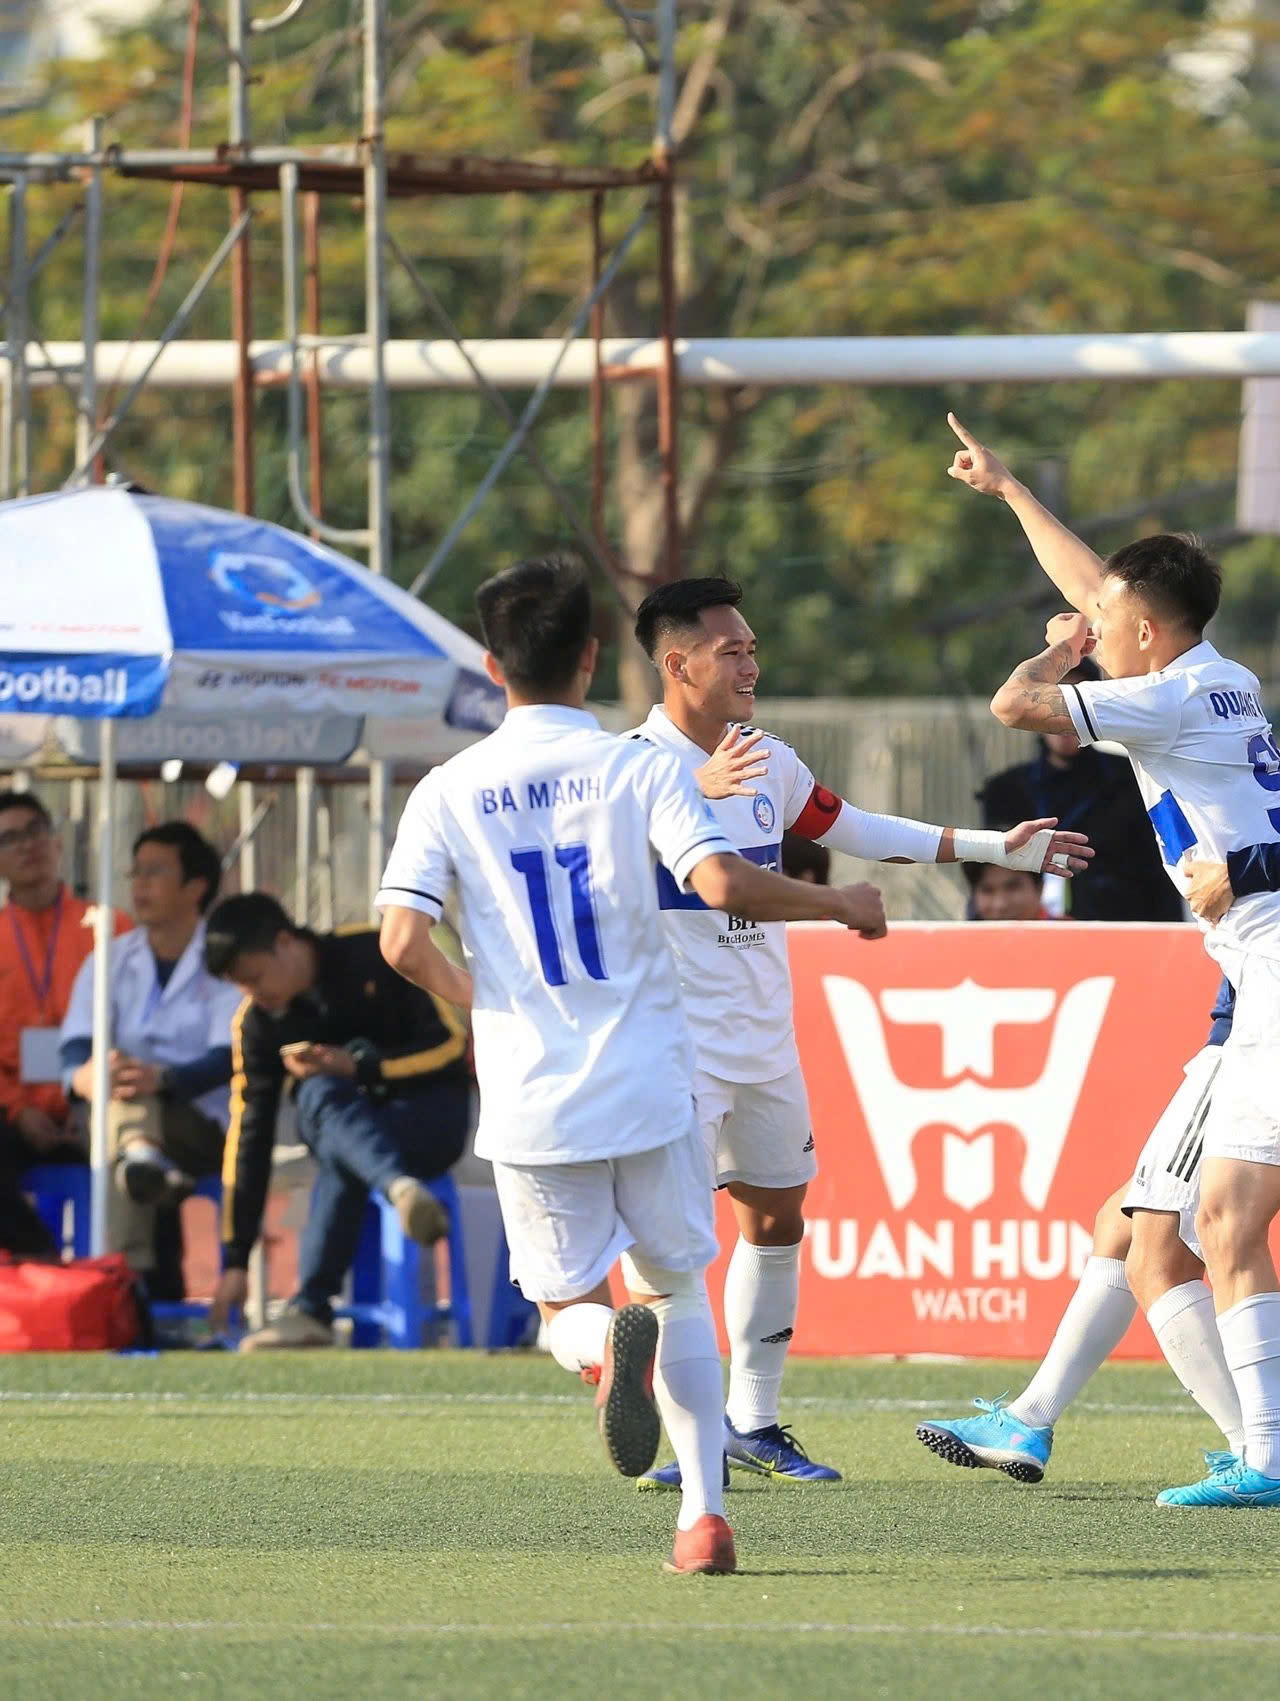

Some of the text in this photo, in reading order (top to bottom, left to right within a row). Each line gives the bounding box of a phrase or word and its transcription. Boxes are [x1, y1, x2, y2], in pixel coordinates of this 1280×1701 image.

[0, 665, 127, 704] ootball
[511, 841, 609, 986] 11
[972, 1218, 1096, 1281] HUN
[912, 1288, 1028, 1322] WATCH
